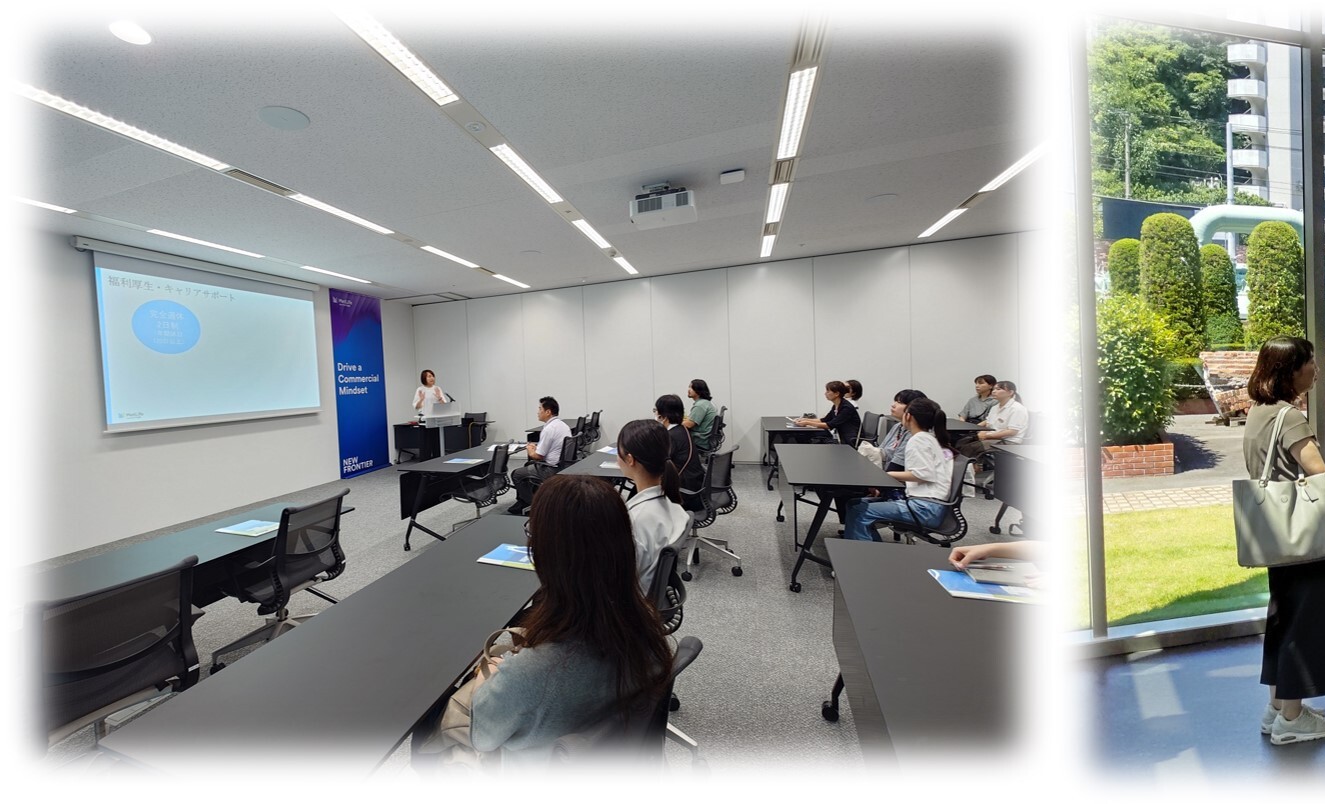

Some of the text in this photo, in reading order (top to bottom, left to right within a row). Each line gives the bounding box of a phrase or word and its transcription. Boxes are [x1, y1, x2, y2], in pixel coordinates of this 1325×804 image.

[337, 363, 362, 372] Drive a
[338, 374, 380, 383] Commercial
[339, 386, 368, 395] Mindset
[343, 456, 359, 467] NEW
[343, 459, 374, 474] FRONTIER
